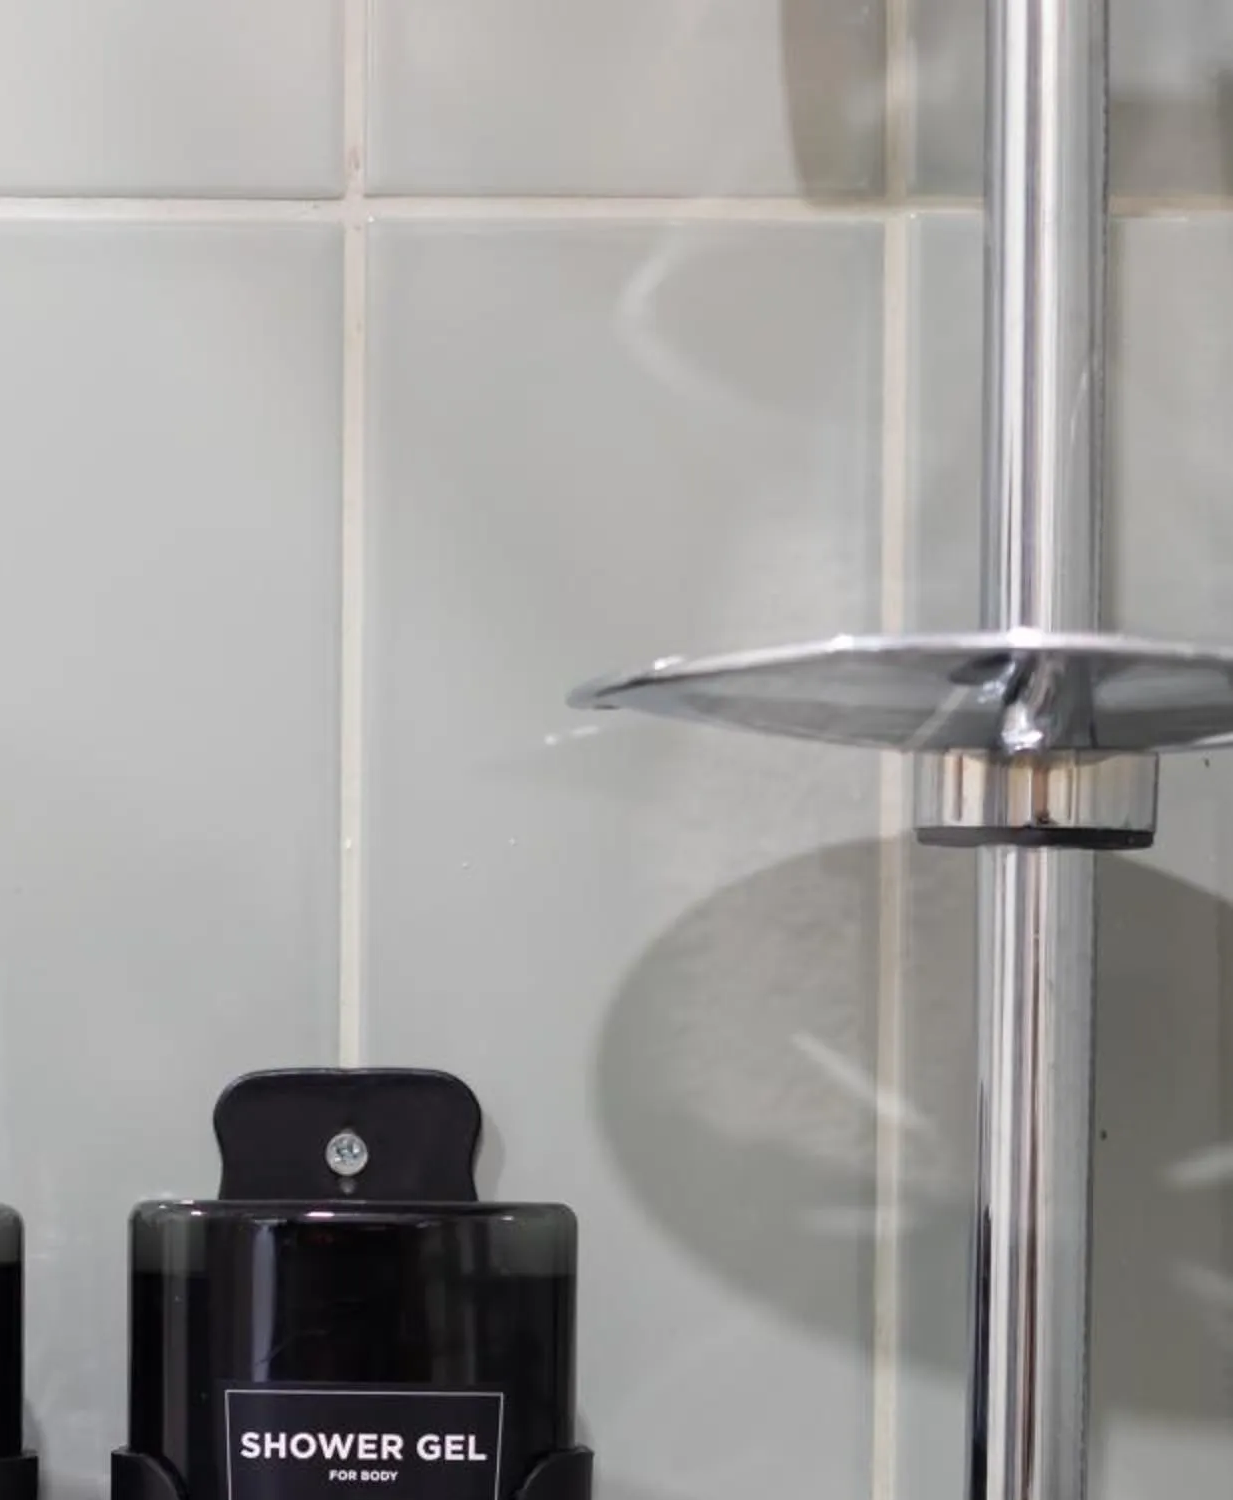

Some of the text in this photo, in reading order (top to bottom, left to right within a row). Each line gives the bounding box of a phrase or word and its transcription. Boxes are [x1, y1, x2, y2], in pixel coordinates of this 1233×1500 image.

[240, 1432, 487, 1461] SHOWER GEL
[329, 1470, 398, 1481] FOR BODY
